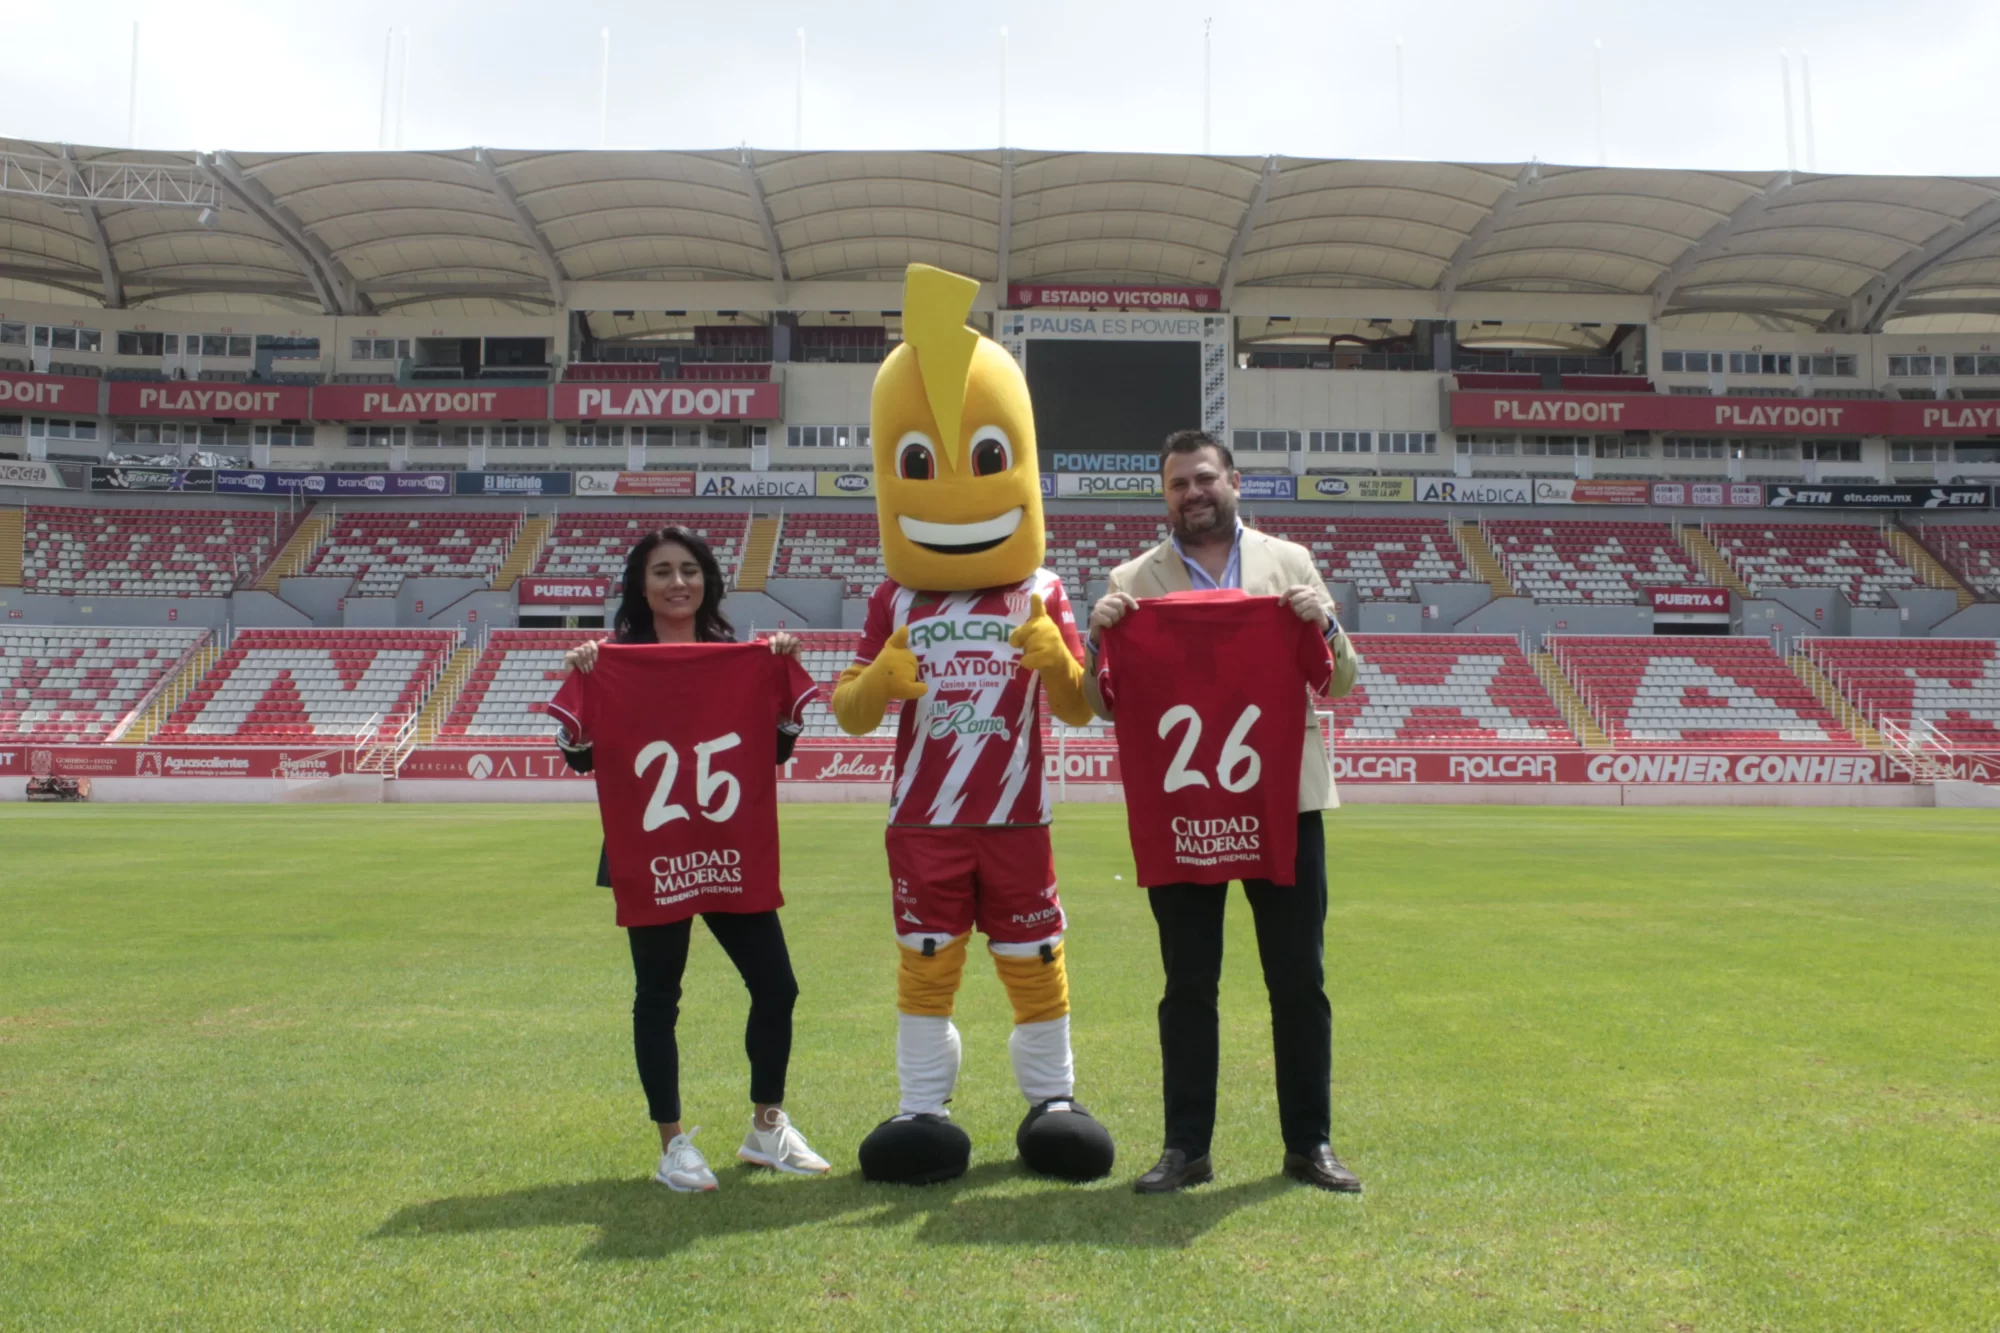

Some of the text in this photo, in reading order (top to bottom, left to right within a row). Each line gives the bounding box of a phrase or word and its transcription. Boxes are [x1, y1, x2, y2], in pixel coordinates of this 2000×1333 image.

[1041, 290, 1190, 305] ESTADIO VICTORIA
[1030, 318, 1200, 335] PAUSA ES POWER
[1752, 344, 1762, 352] 47
[140, 388, 280, 411] PLAYDOIT
[363, 392, 497, 412] PLAYDOIT
[578, 388, 755, 416] PLAYDOIT
[1494, 400, 1625, 421] PLAYDOIT
[1716, 405, 1842, 427] PLAYDOIT
[1923, 408, 2000, 428] PLAY
[485, 476, 542, 488] El Heraldo
[702, 476, 808, 496] AR MÉDICA
[837, 478, 867, 488] NOEL
[1079, 477, 1155, 495] ROLCAR
[1318, 480, 1347, 491] NOEL
[1423, 482, 1456, 501] AR
[1462, 484, 1526, 502] MÉDICA
[1796, 492, 1832, 503] ETN
[1843, 493, 1912, 503] etn.com.mx
[1949, 492, 1985, 504] ETN
[534, 585, 604, 597] PUERTA 5
[1655, 594, 1724, 606] PUERTA 4
[918, 660, 1020, 680] PLAYDOIT
[941, 680, 965, 689] Casino
[1158, 704, 1261, 793] 26
[164, 756, 249, 770] Aguascalientes
[280, 759, 326, 771] gigante
[816, 752, 876, 780] Salsa
[1450, 756, 1556, 783] ROLCAR
[1587, 755, 1876, 783] GONHER GONHER
[290, 769, 330, 779] México
[634, 732, 742, 832] 25
[1171, 816, 1259, 837] CIUDAD
[1175, 835, 1260, 854] MADERAS
[650, 849, 740, 876] CIUDAD
[1176, 854, 1260, 866] TERRENOS PREMIUM
[654, 868, 741, 894] MADERAS
[655, 886, 742, 905] TERRENOS PREMIUM
